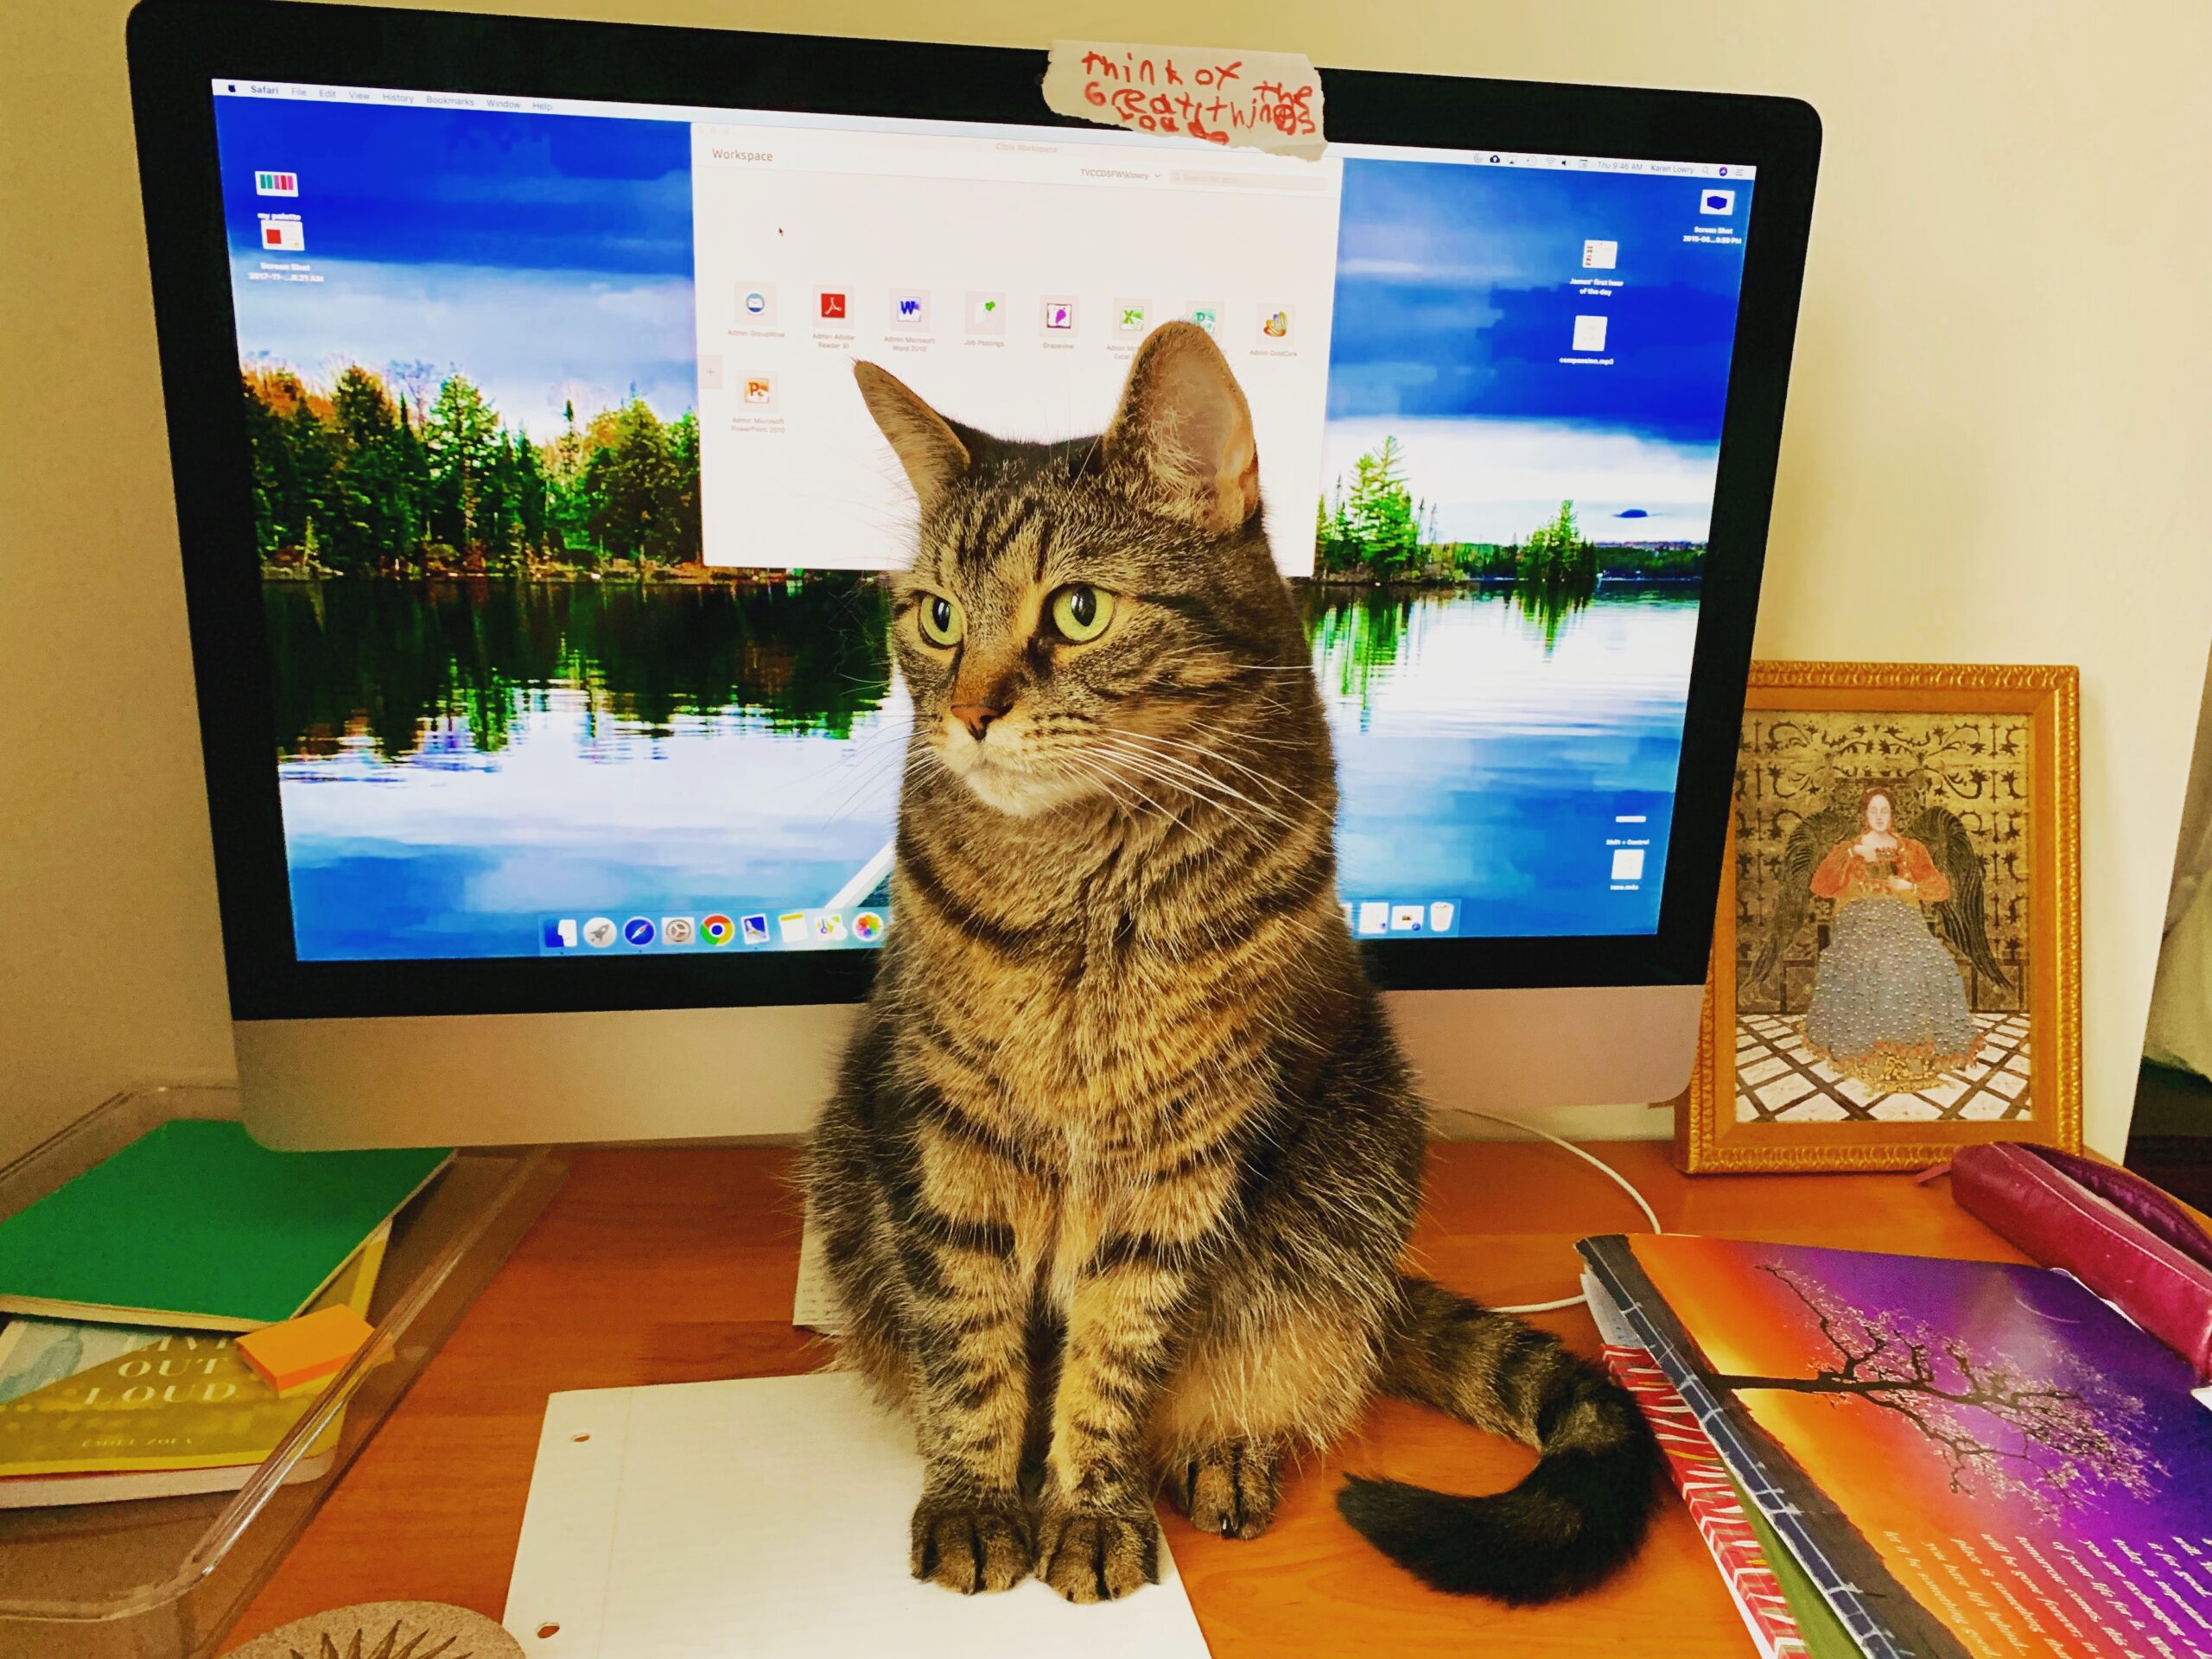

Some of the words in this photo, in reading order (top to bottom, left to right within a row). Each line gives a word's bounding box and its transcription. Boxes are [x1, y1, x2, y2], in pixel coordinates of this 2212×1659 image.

[251, 85, 279, 95] Safari
[291, 87, 308, 97] File
[319, 89, 337, 99] Edit
[348, 91, 371, 100] View
[382, 92, 414, 105] History
[426, 95, 475, 106] Bookmarks
[486, 98, 521, 109] Window
[532, 100, 553, 112] Help
[712, 148, 773, 163] Workspace
[1673, 165, 1694, 175] Lowry
[118, 1357, 229, 1377] OUT
[2052, 1541, 2075, 1554] of
[1883, 1530, 1901, 1542] let
[1905, 1556, 1921, 1569] be
[1917, 1572, 1968, 1624] something
[1921, 1541, 1948, 1560] you
[1943, 1564, 1971, 1588] have
[1966, 1591, 1991, 1607] left
[1980, 1534, 2010, 1553] will
[2001, 1555, 2018, 1567] be
[2011, 1569, 2044, 1594] gone
[2060, 1554, 2094, 1579] your
[1949, 1538, 1983, 1564] place
[1979, 1568, 1994, 1577] is
[1991, 1580, 2046, 1633] something
[2015, 1535, 2068, 1586] tomorrow
[2101, 1626, 2127, 1646] this
[2078, 1539, 2107, 1558] you
[2122, 1580, 2186, 1637] exchanging
[2090, 1581, 2115, 1598] life
[2106, 1600, 2133, 1617] for
